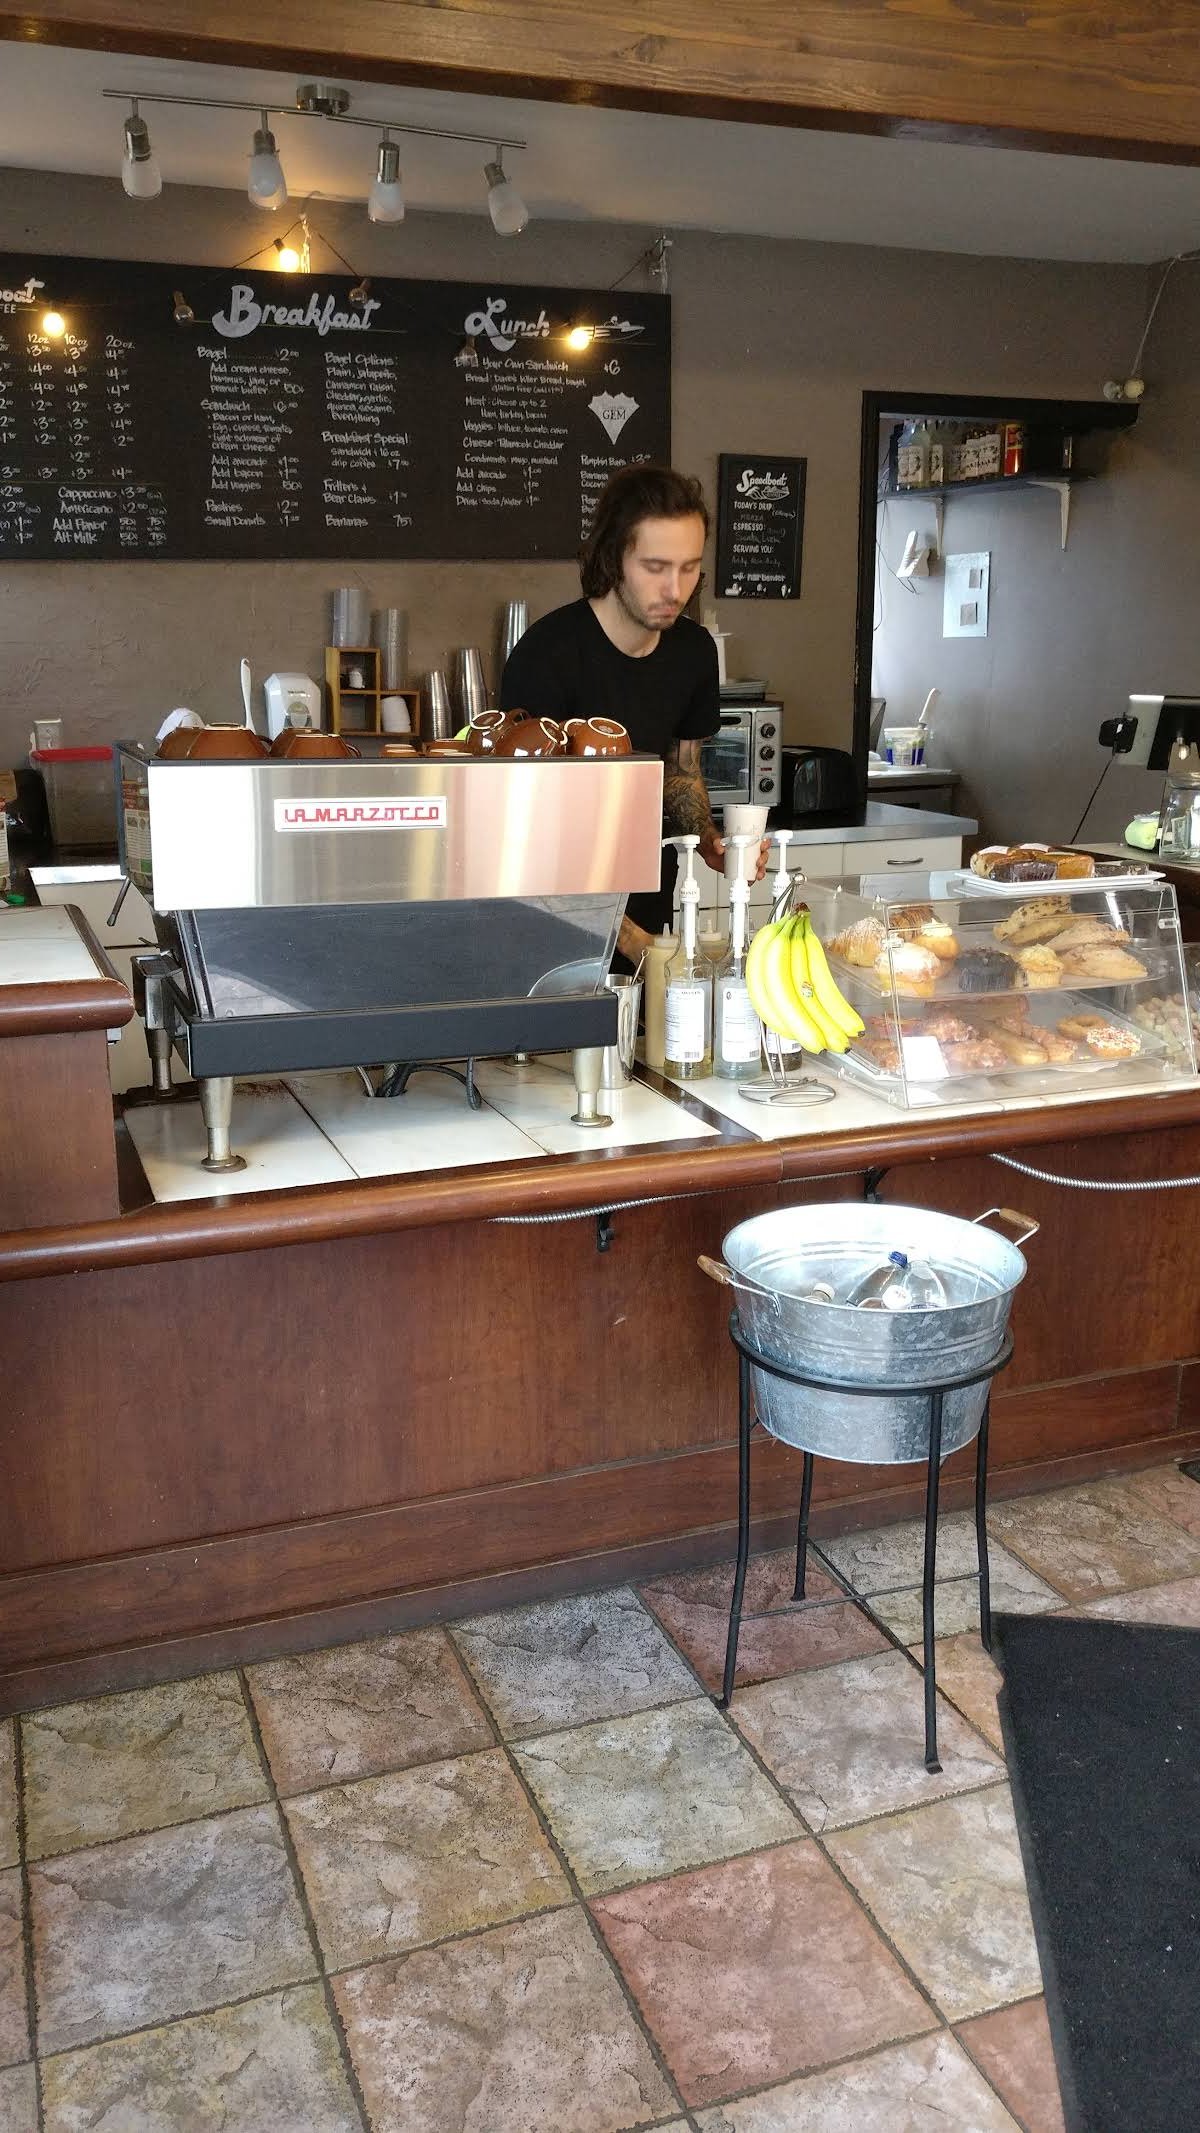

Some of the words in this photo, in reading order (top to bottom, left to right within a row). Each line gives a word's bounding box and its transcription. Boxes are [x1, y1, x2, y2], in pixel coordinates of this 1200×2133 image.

[0, 277, 45, 303] oat
[211, 284, 381, 338] Breakfast
[464, 296, 550, 352] Lunch
[197, 346, 227, 362] Bagel
[525, 359, 569, 372] Sandwich
[200, 399, 250, 412] Sandwich
[602, 409, 626, 420] GEM
[456, 466, 474, 478] Add
[456, 481, 473, 492] Add
[736, 469, 788, 492] Speedboat
[205, 499, 243, 513] Pastries
[53, 517, 73, 531] Add
[325, 514, 369, 527] Bananas
[74, 531, 98, 544] Milk
[732, 544, 760, 554] SERVING
